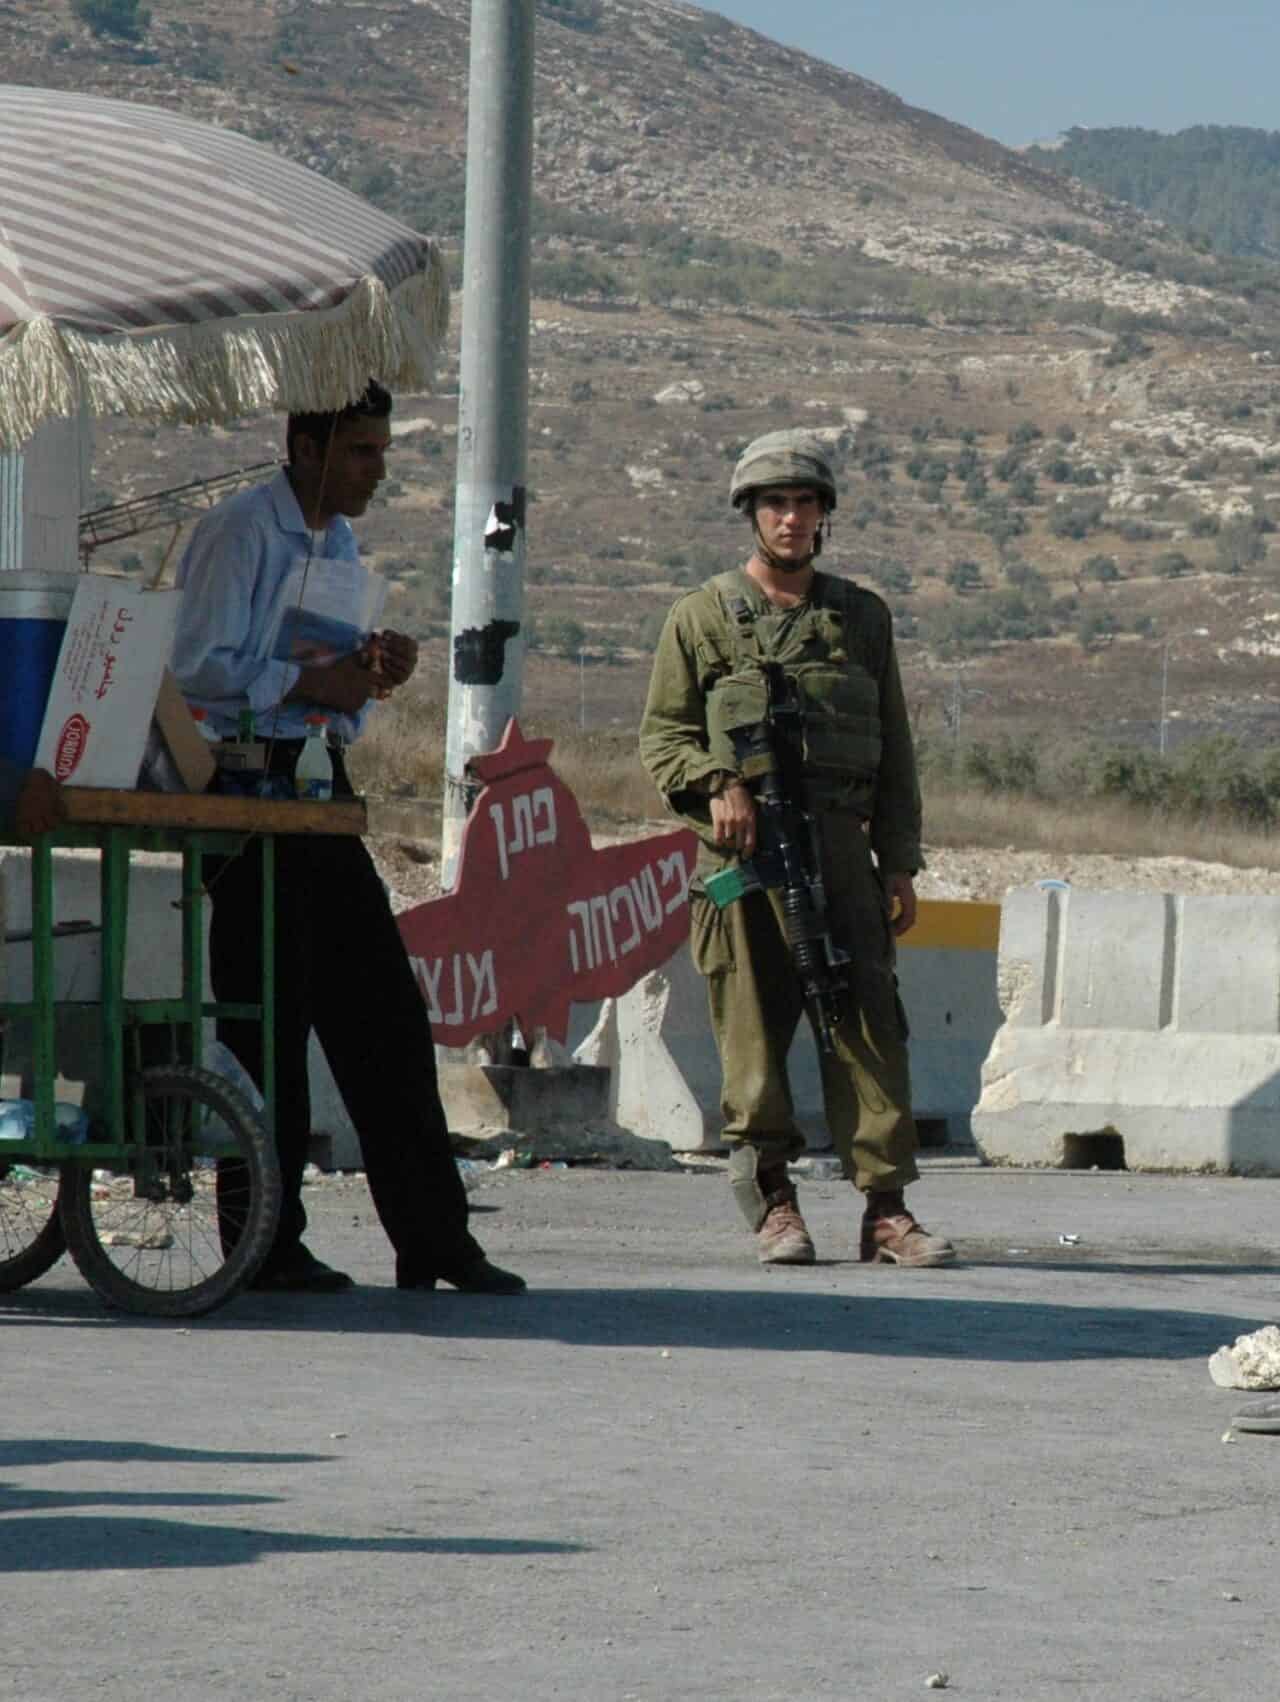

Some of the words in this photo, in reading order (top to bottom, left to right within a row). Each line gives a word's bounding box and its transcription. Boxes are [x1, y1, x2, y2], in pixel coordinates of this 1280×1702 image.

[488, 786, 558, 881] פתן
[566, 849, 690, 974] משפחה
[407, 948, 499, 1026] מנצ
